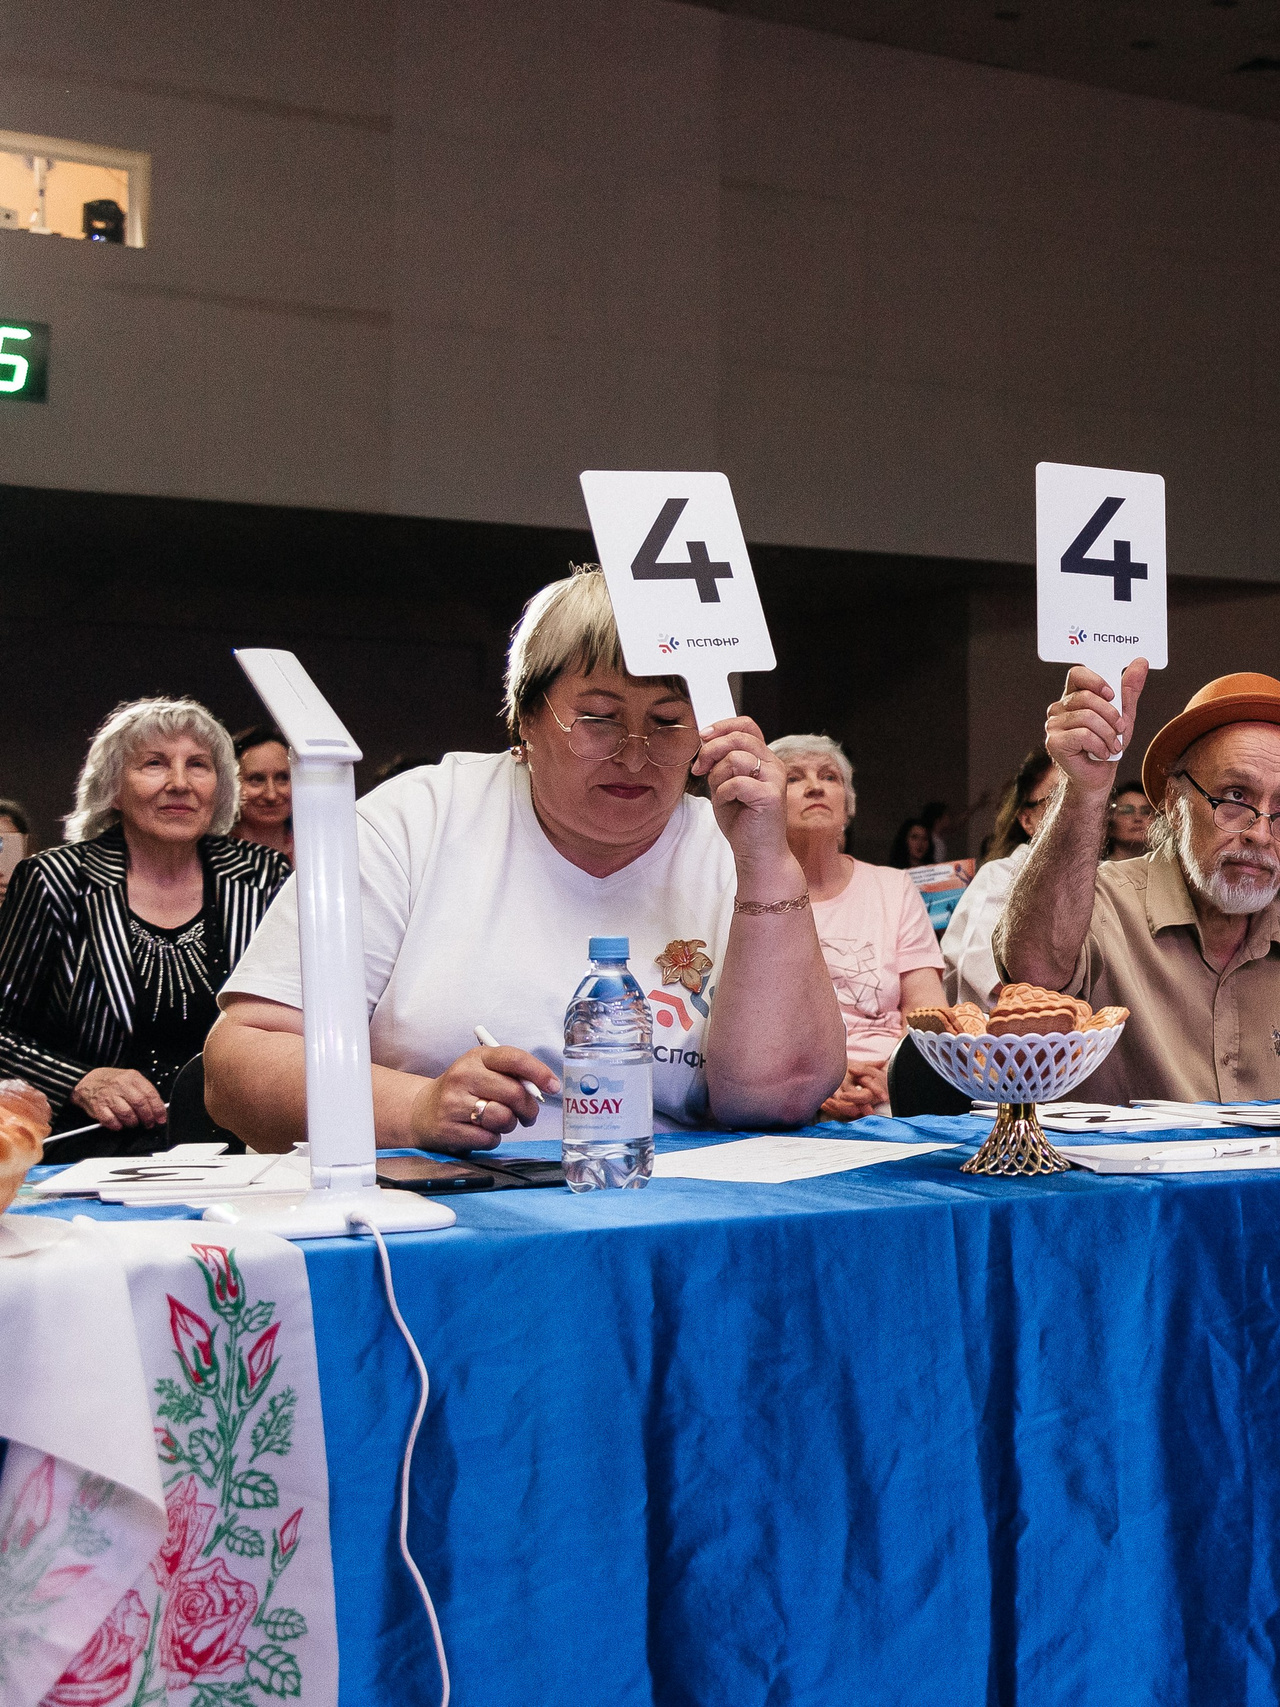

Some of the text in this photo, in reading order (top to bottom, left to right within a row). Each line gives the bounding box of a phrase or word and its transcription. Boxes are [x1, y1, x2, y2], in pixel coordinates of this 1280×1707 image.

[630, 498, 734, 603] 4
[1060, 496, 1148, 602] 4
[686, 637, 740, 648] ПСПФНР
[1093, 633, 1140, 645] ПСПФНР
[565, 1098, 624, 1115] TASSAY
